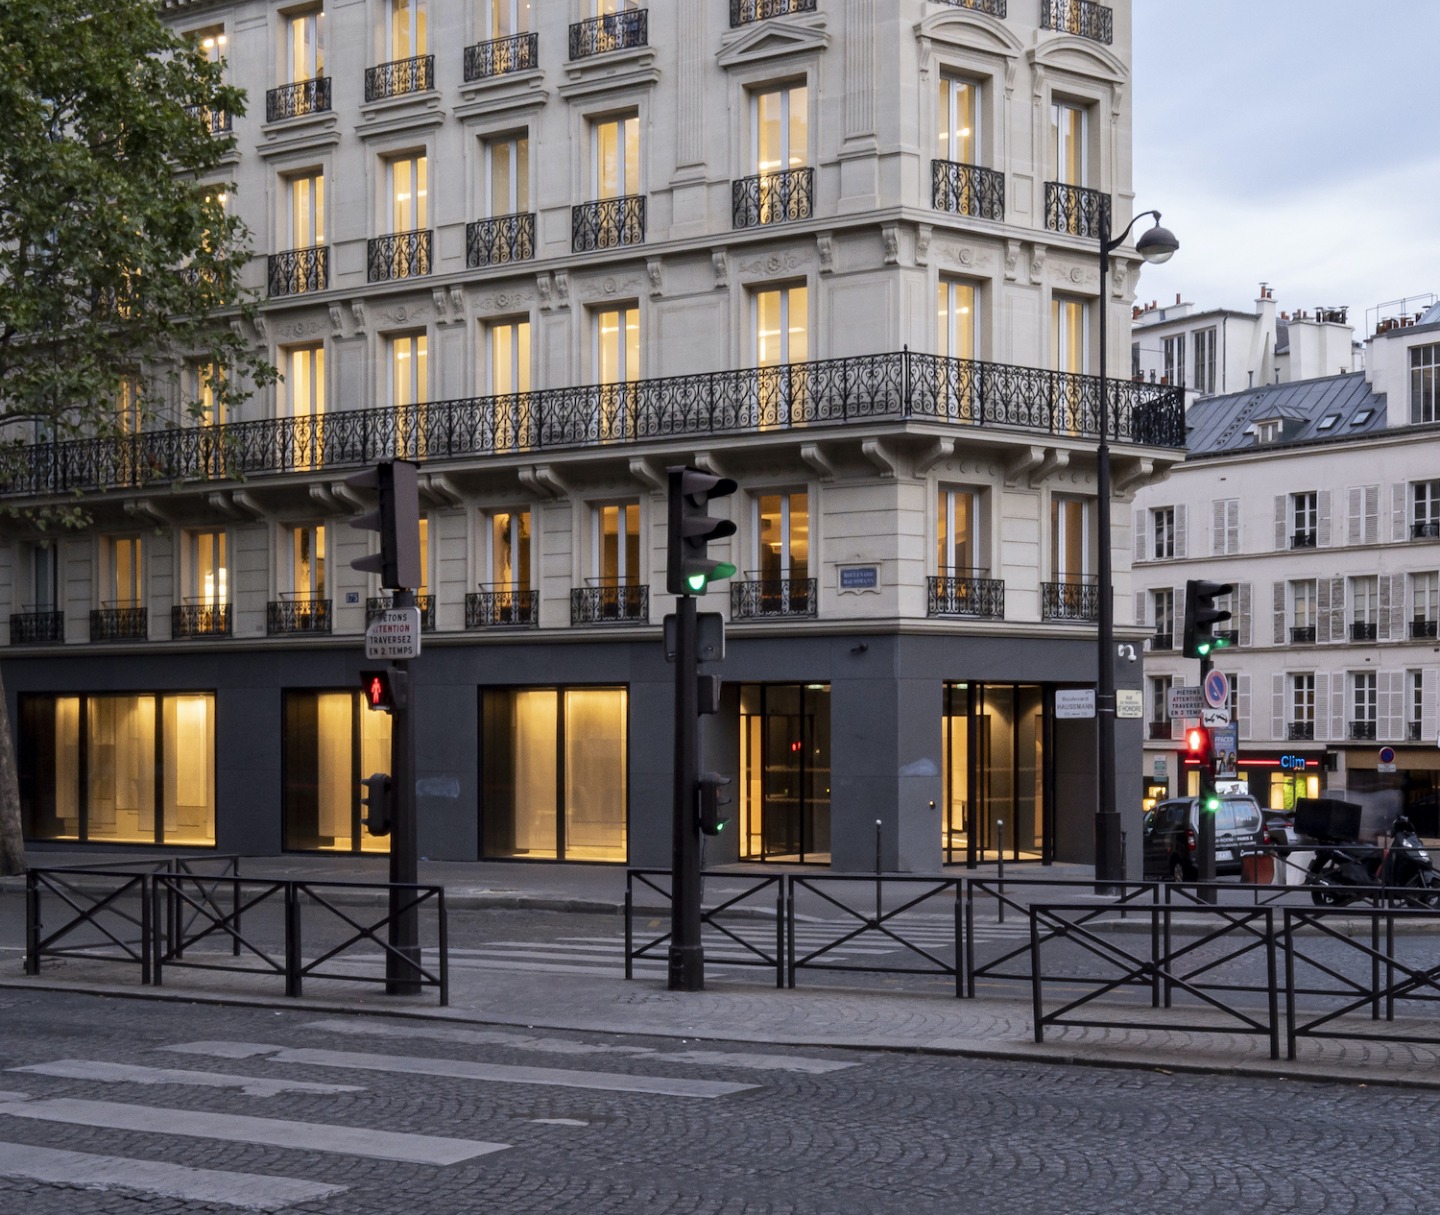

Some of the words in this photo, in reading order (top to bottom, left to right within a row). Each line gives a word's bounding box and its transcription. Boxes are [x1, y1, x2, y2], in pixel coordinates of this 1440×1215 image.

[370, 635, 411, 644] TRAVERSEZ
[369, 647, 379, 655] EN
[380, 647, 386, 655] 2
[388, 646, 413, 655] TEMPS
[1280, 756, 1306, 768] Clim
